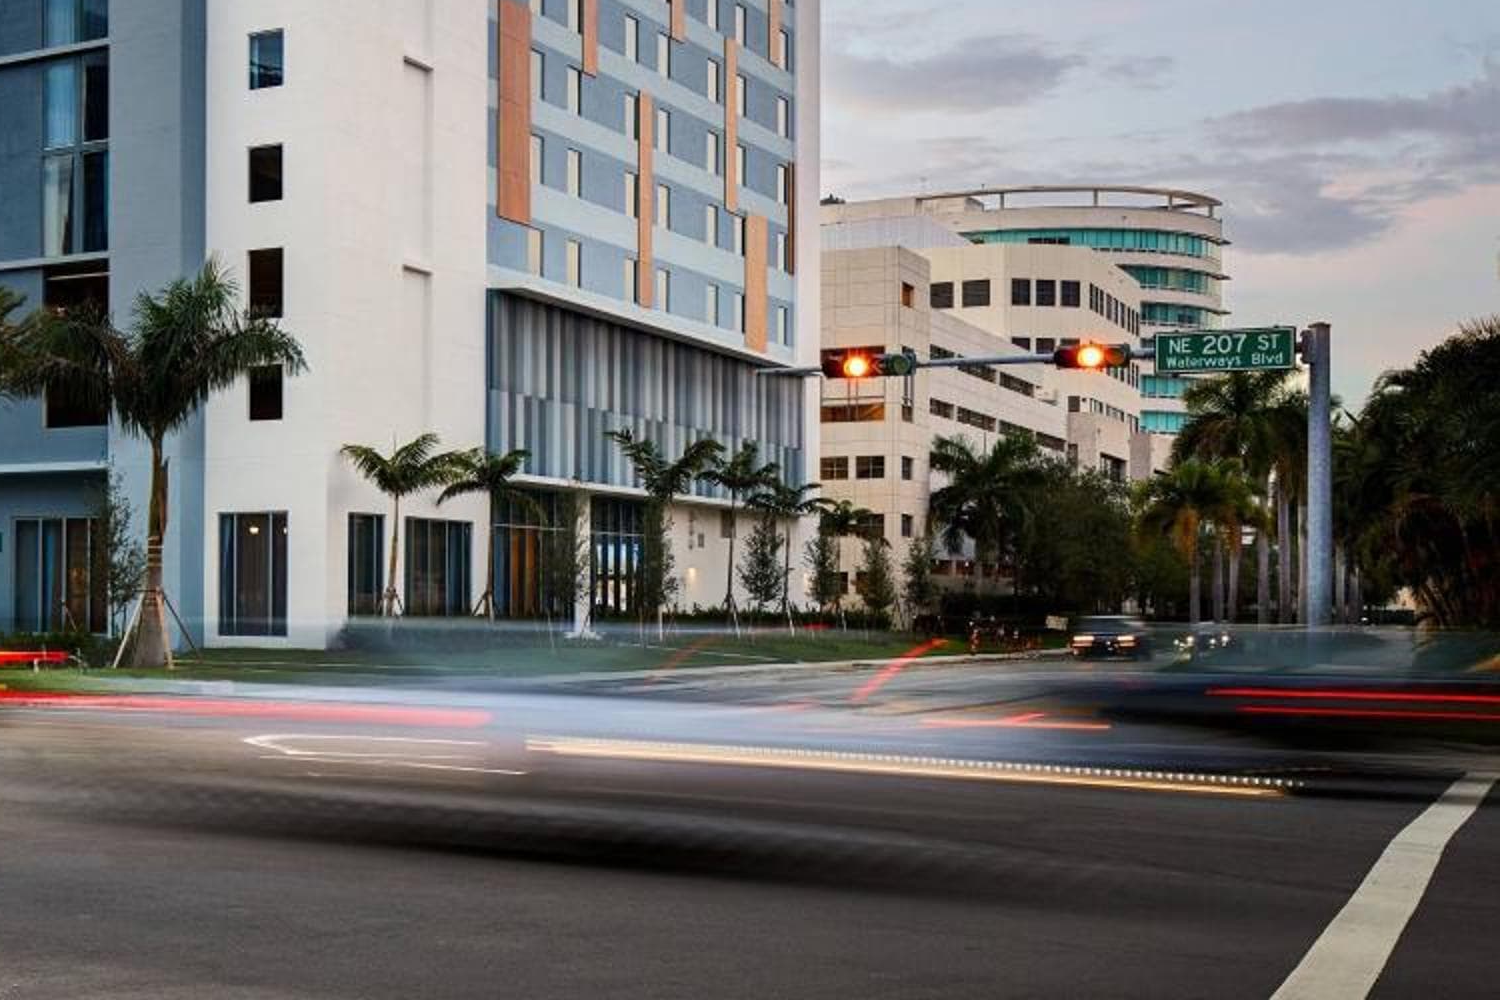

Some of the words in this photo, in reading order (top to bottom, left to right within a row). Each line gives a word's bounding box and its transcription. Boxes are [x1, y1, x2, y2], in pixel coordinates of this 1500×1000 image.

[1168, 337, 1192, 354] NE
[1202, 334, 1247, 355] 207
[1257, 333, 1281, 351] ST
[1166, 355, 1242, 369] Waterways
[1251, 352, 1284, 365] Blvd
